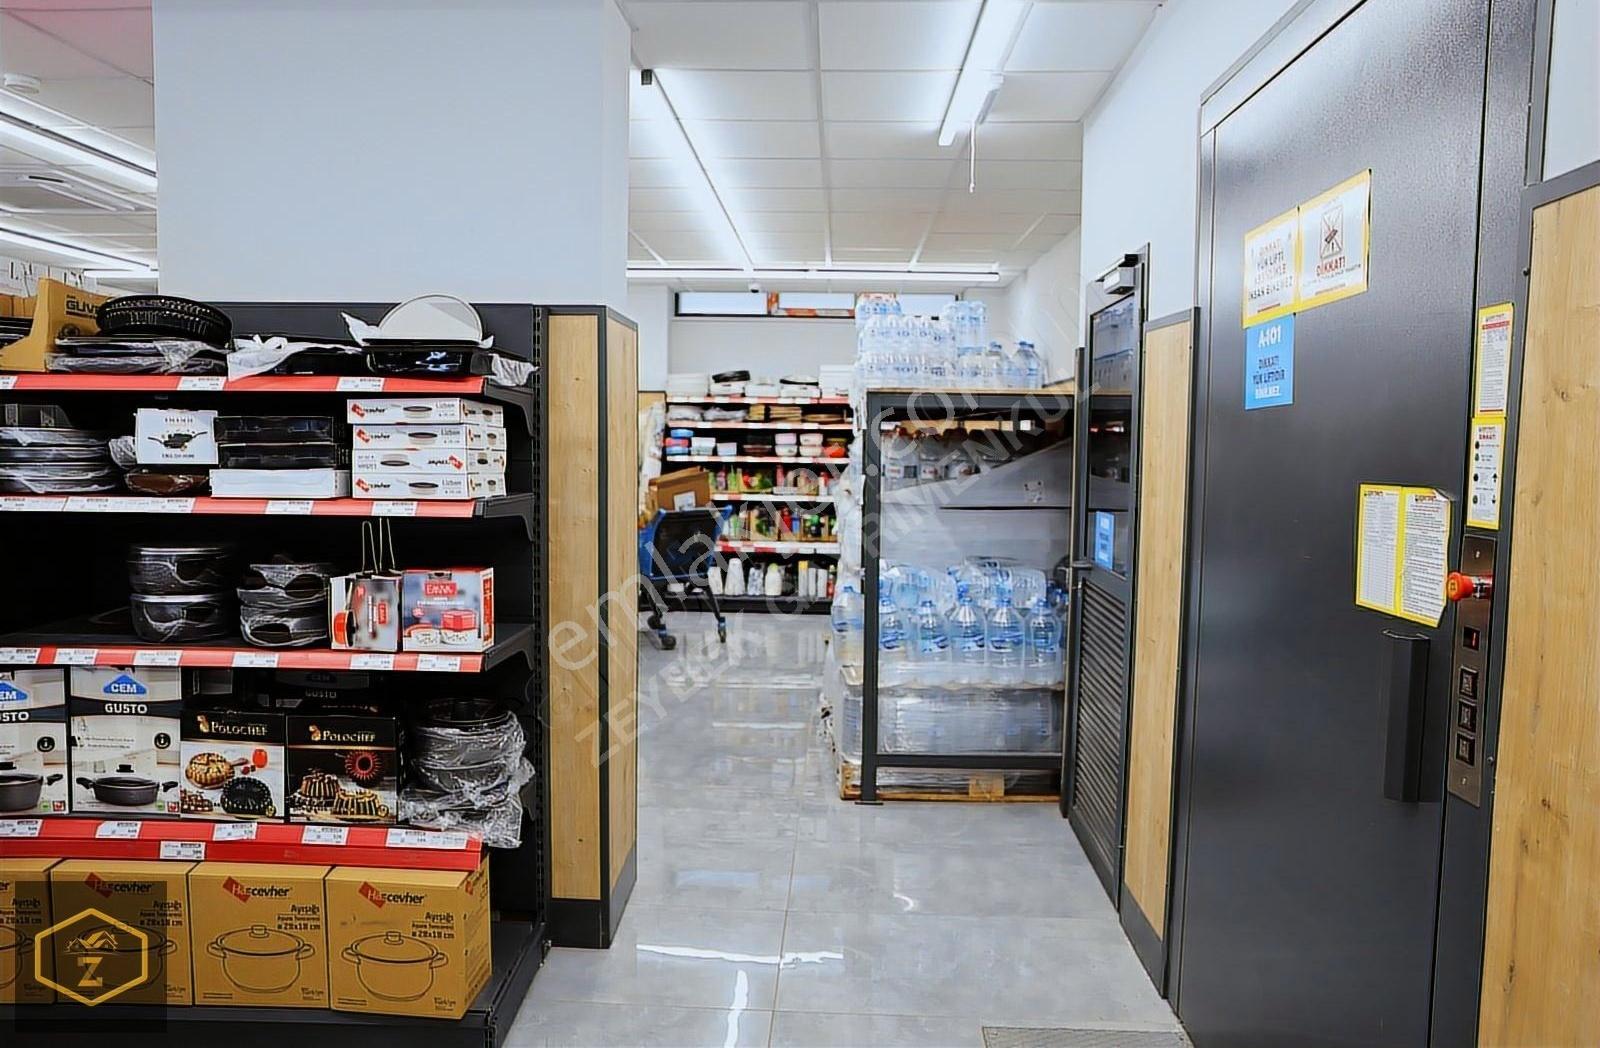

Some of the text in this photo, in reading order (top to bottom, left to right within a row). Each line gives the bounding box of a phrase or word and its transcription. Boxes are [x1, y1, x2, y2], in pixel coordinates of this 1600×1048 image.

[111, 684, 137, 693] CEM
[105, 703, 148, 714] GUSTO
[0, 711, 29, 722] STO
